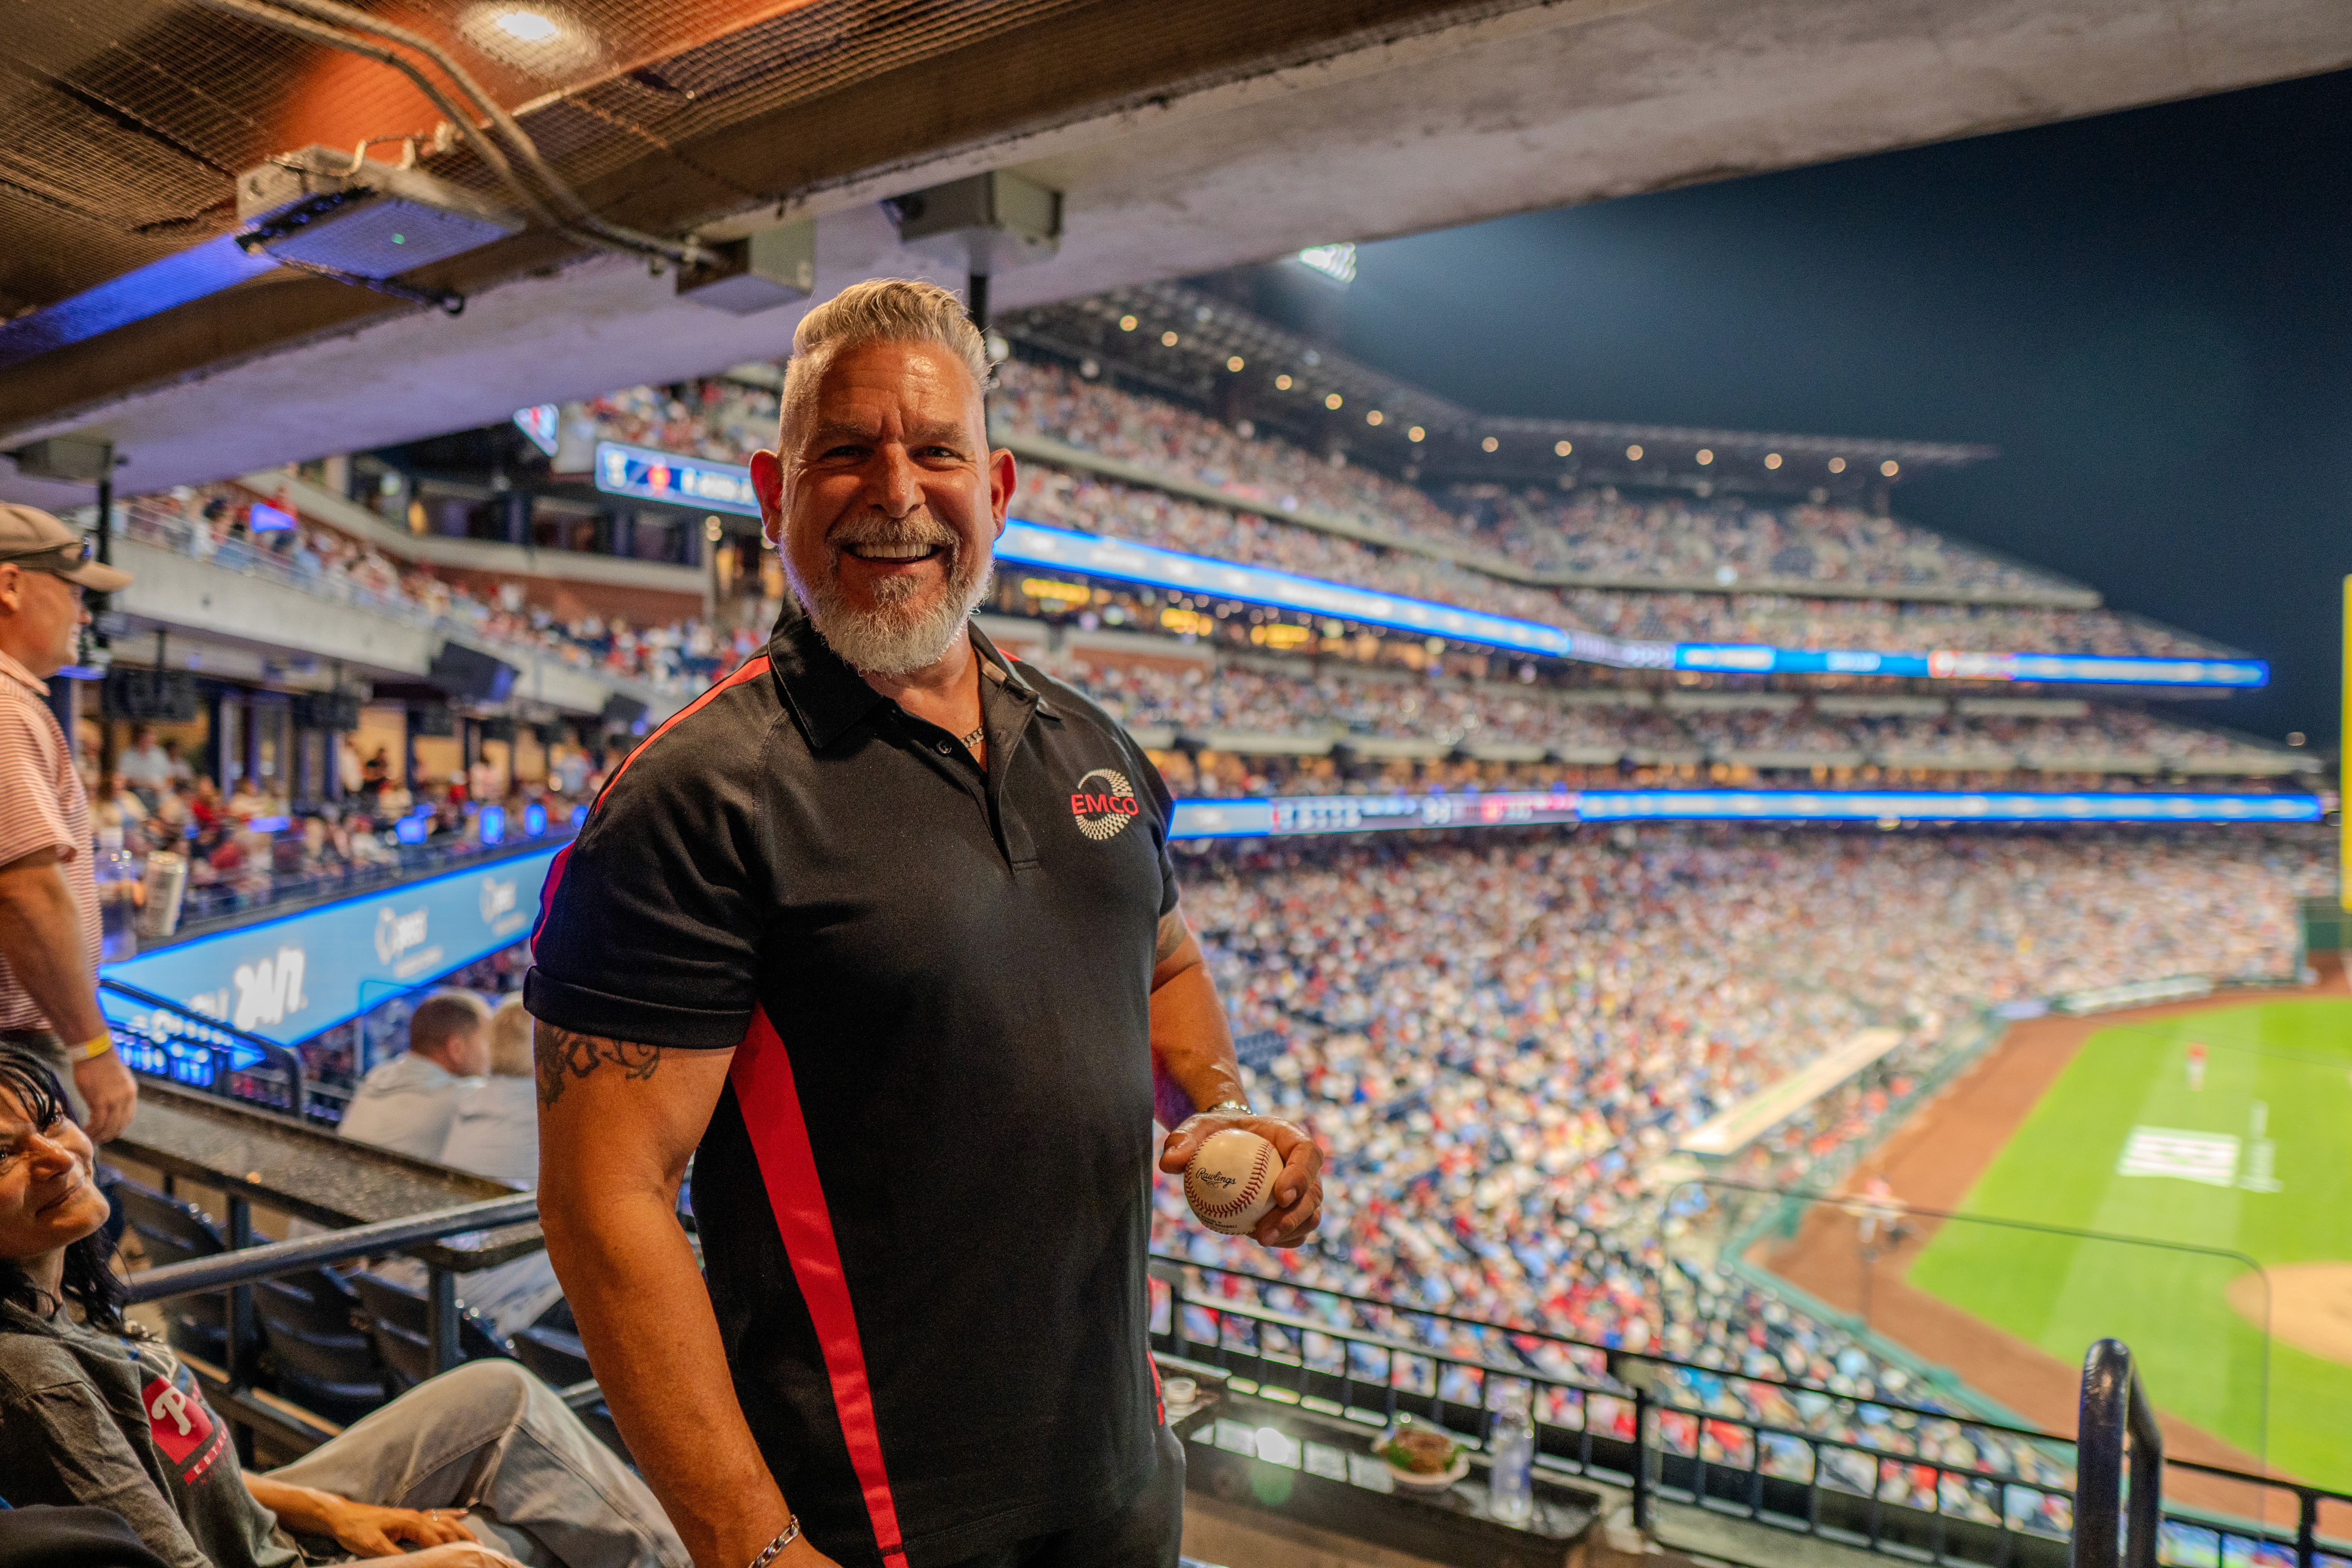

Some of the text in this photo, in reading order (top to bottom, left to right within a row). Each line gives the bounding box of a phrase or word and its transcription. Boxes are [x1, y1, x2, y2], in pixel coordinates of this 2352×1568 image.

[1070, 793, 1139, 816] EMCO
[1195, 1168, 1236, 1189] Rawlings
[152, 1386, 191, 1436] P
